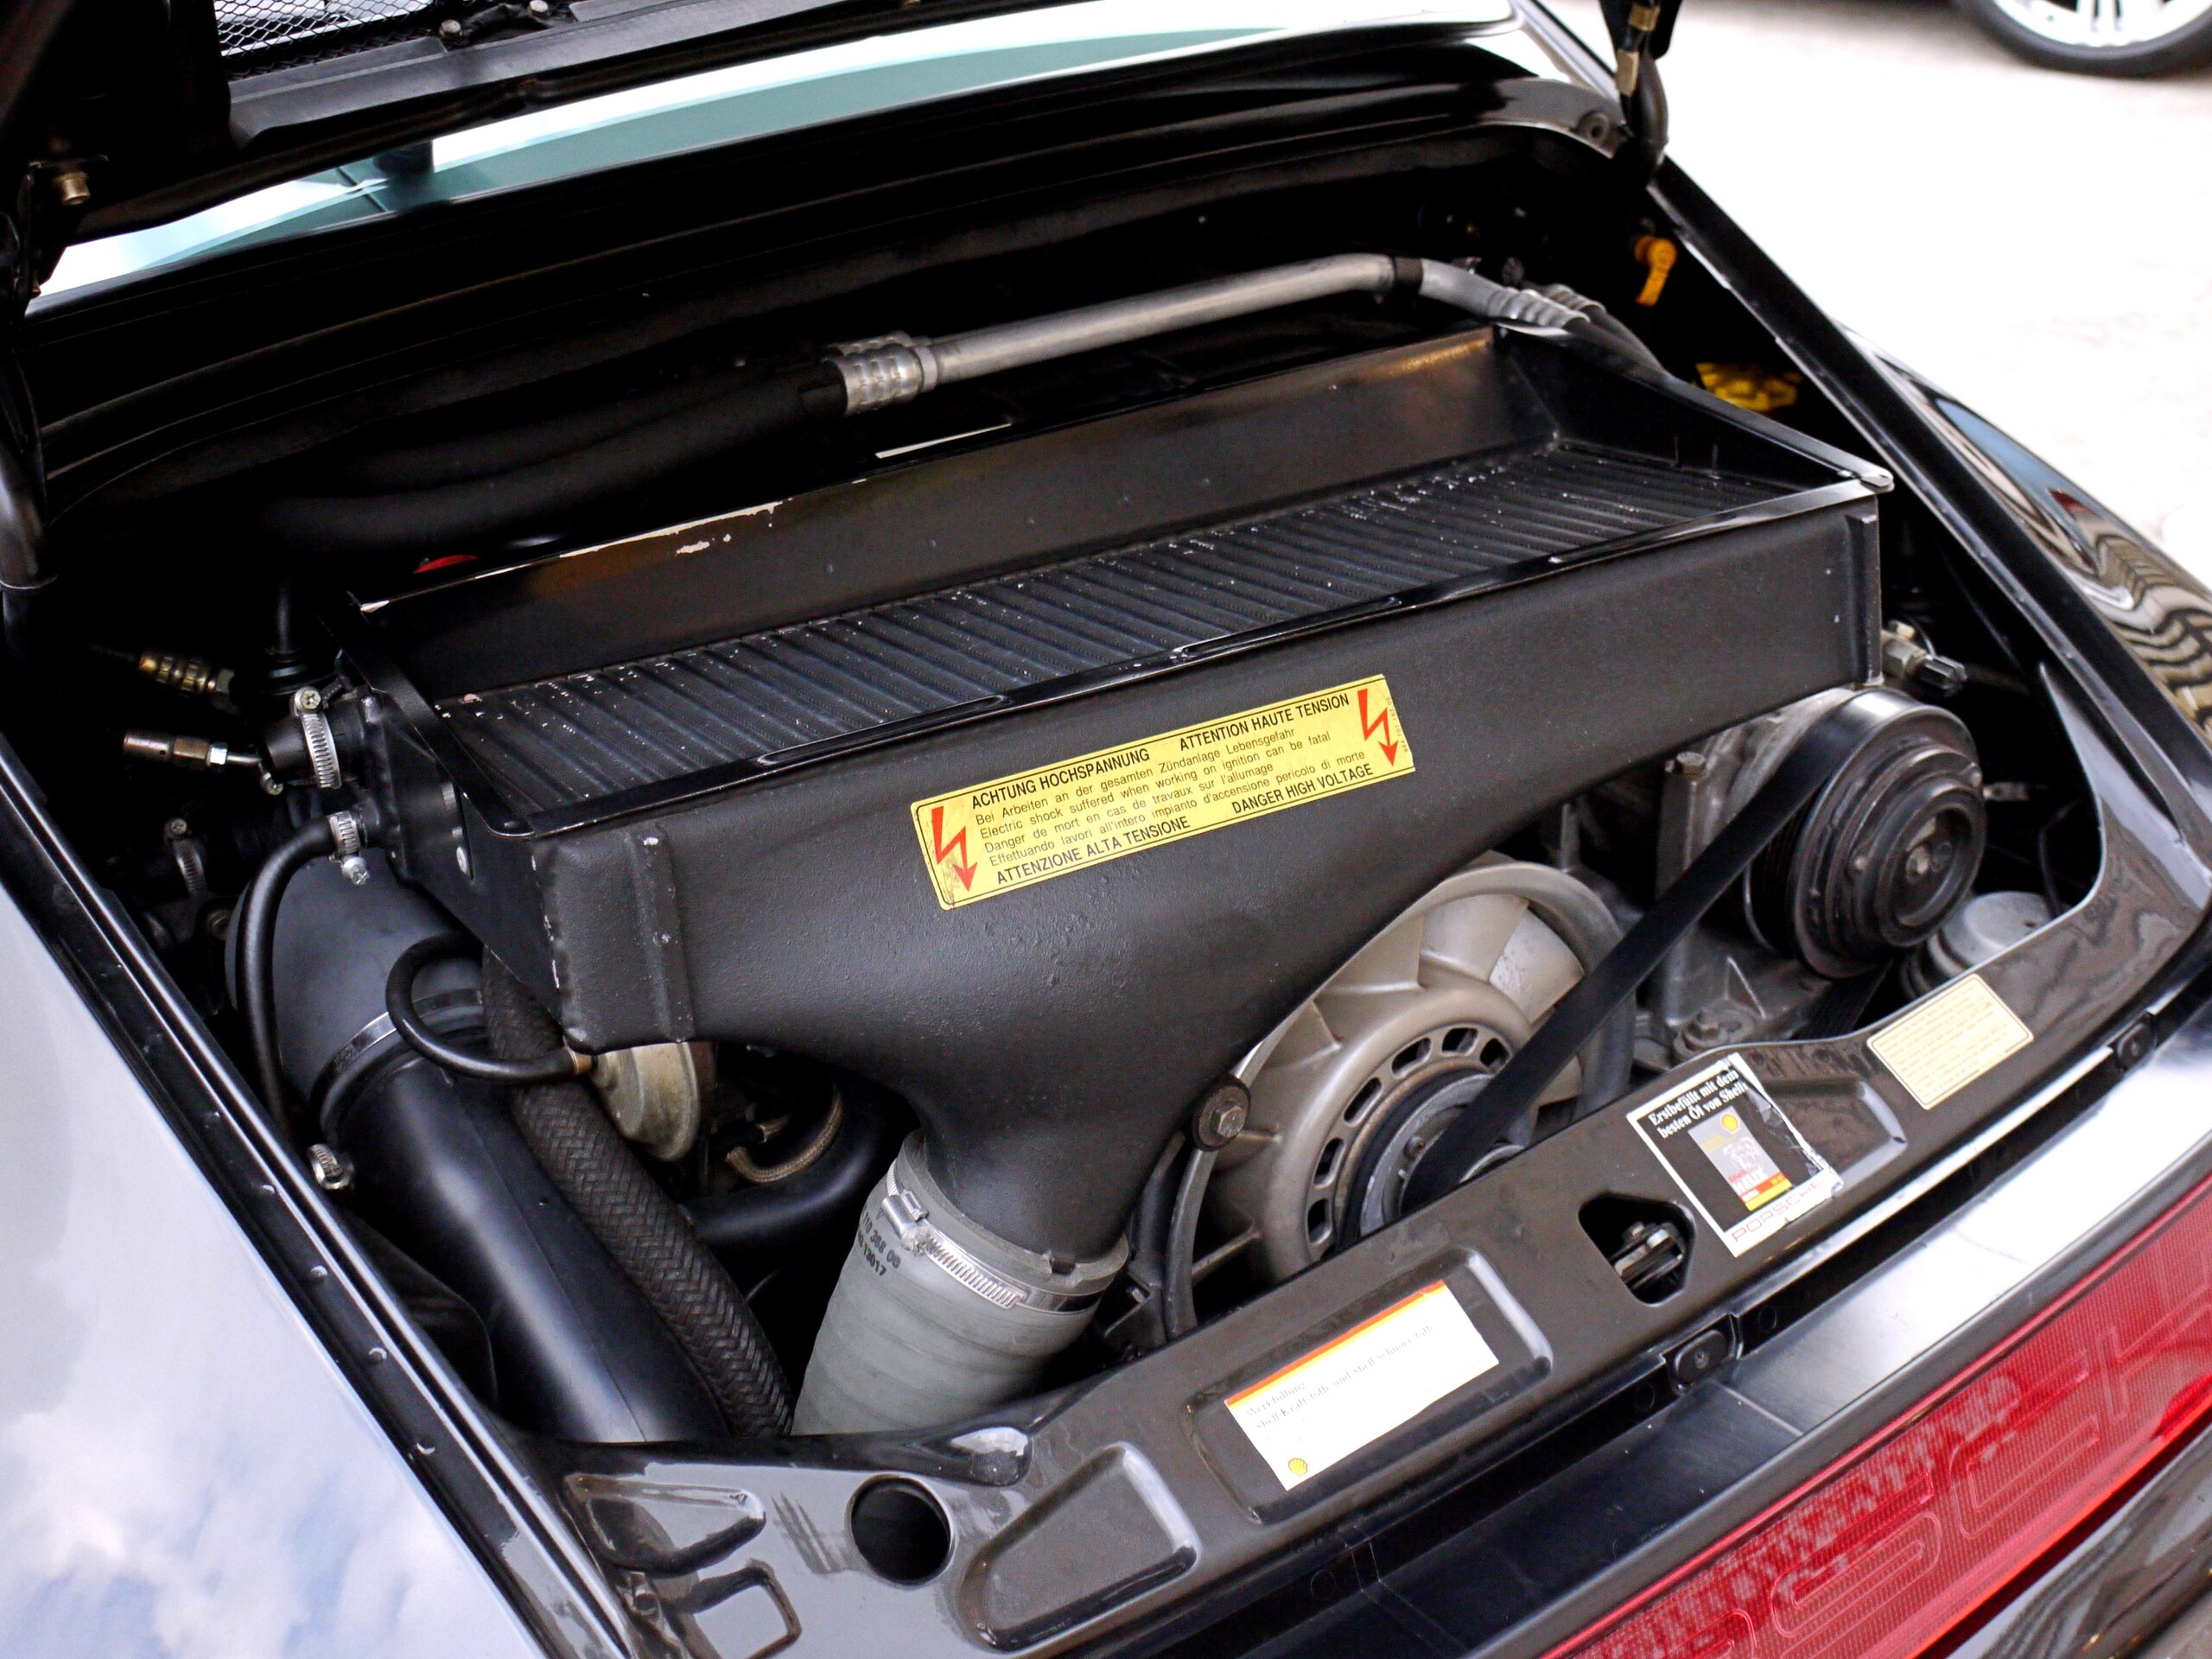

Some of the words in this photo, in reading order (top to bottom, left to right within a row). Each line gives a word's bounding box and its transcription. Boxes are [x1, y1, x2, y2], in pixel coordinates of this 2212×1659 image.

[1180, 721, 1249, 751] ATTENTION
[1251, 709, 1294, 732] HAUTE
[1295, 693, 1350, 719] TENSION
[972, 780, 1036, 810] ACHTUNG
[1039, 748, 1150, 790] HOCHSPANNUNG
[976, 812, 995, 826] Bei
[1002, 798, 1049, 818] Arbeiten
[1055, 792, 1070, 803] an
[1076, 785, 1094, 798] der
[1101, 769, 1154, 792] gesamten
[1158, 749, 1221, 773] Zündanlage
[1226, 728, 1296, 754] Lebensgefahr
[980, 820, 1023, 840] Electric
[1030, 808, 1064, 825] shock
[1070, 793, 1115, 814] suffered
[1121, 784, 1149, 799] when
[1155, 770, 1198, 789] working
[1204, 766, 1217, 775] on
[1222, 752, 1261, 772] ignition
[1266, 746, 1285, 759] can
[1289, 740, 1303, 752] be
[1308, 732, 1331, 747] fatal
[984, 835, 1026, 854] Danger
[1033, 829, 1047, 839] de
[1054, 822, 1080, 834] mort
[1087, 813, 1100, 823] en
[1107, 806, 1127, 817] cas
[1133, 798, 1147, 810] de
[1153, 786, 1193, 804] travaux
[1198, 779, 1216, 791] sur
[1221, 763, 1274, 785] l'allumage
[989, 842, 1055, 867] Effettuando
[1062, 830, 1093, 845] lavori
[1099, 815, 1146, 834] all'intero
[1152, 799, 1198, 821] impianto
[1204, 779, 1270, 804] d'accensione
[1275, 766, 1316, 785] pericolo
[1320, 759, 1332, 770] di
[1337, 751, 1365, 766] morte
[1232, 788, 1284, 814] DANGER
[1287, 781, 1316, 799] HIGH
[1318, 764, 1373, 790] VOLTAGE
[997, 849, 1083, 885] ATTENZIONE
[1087, 836, 1122, 857] ALTA
[1124, 816, 1190, 844] TENSIONE
[1648, 1090, 1701, 1126] Erstbefüllt
[1699, 1080, 1718, 1097] mit
[1715, 1069, 1739, 1088] dem
[1657, 1115, 1692, 1139] besten
[1688, 1105, 1705, 1120] Öl
[1702, 1096, 1723, 1113] von
[1732, 1179, 1826, 1243] PORSCHE
